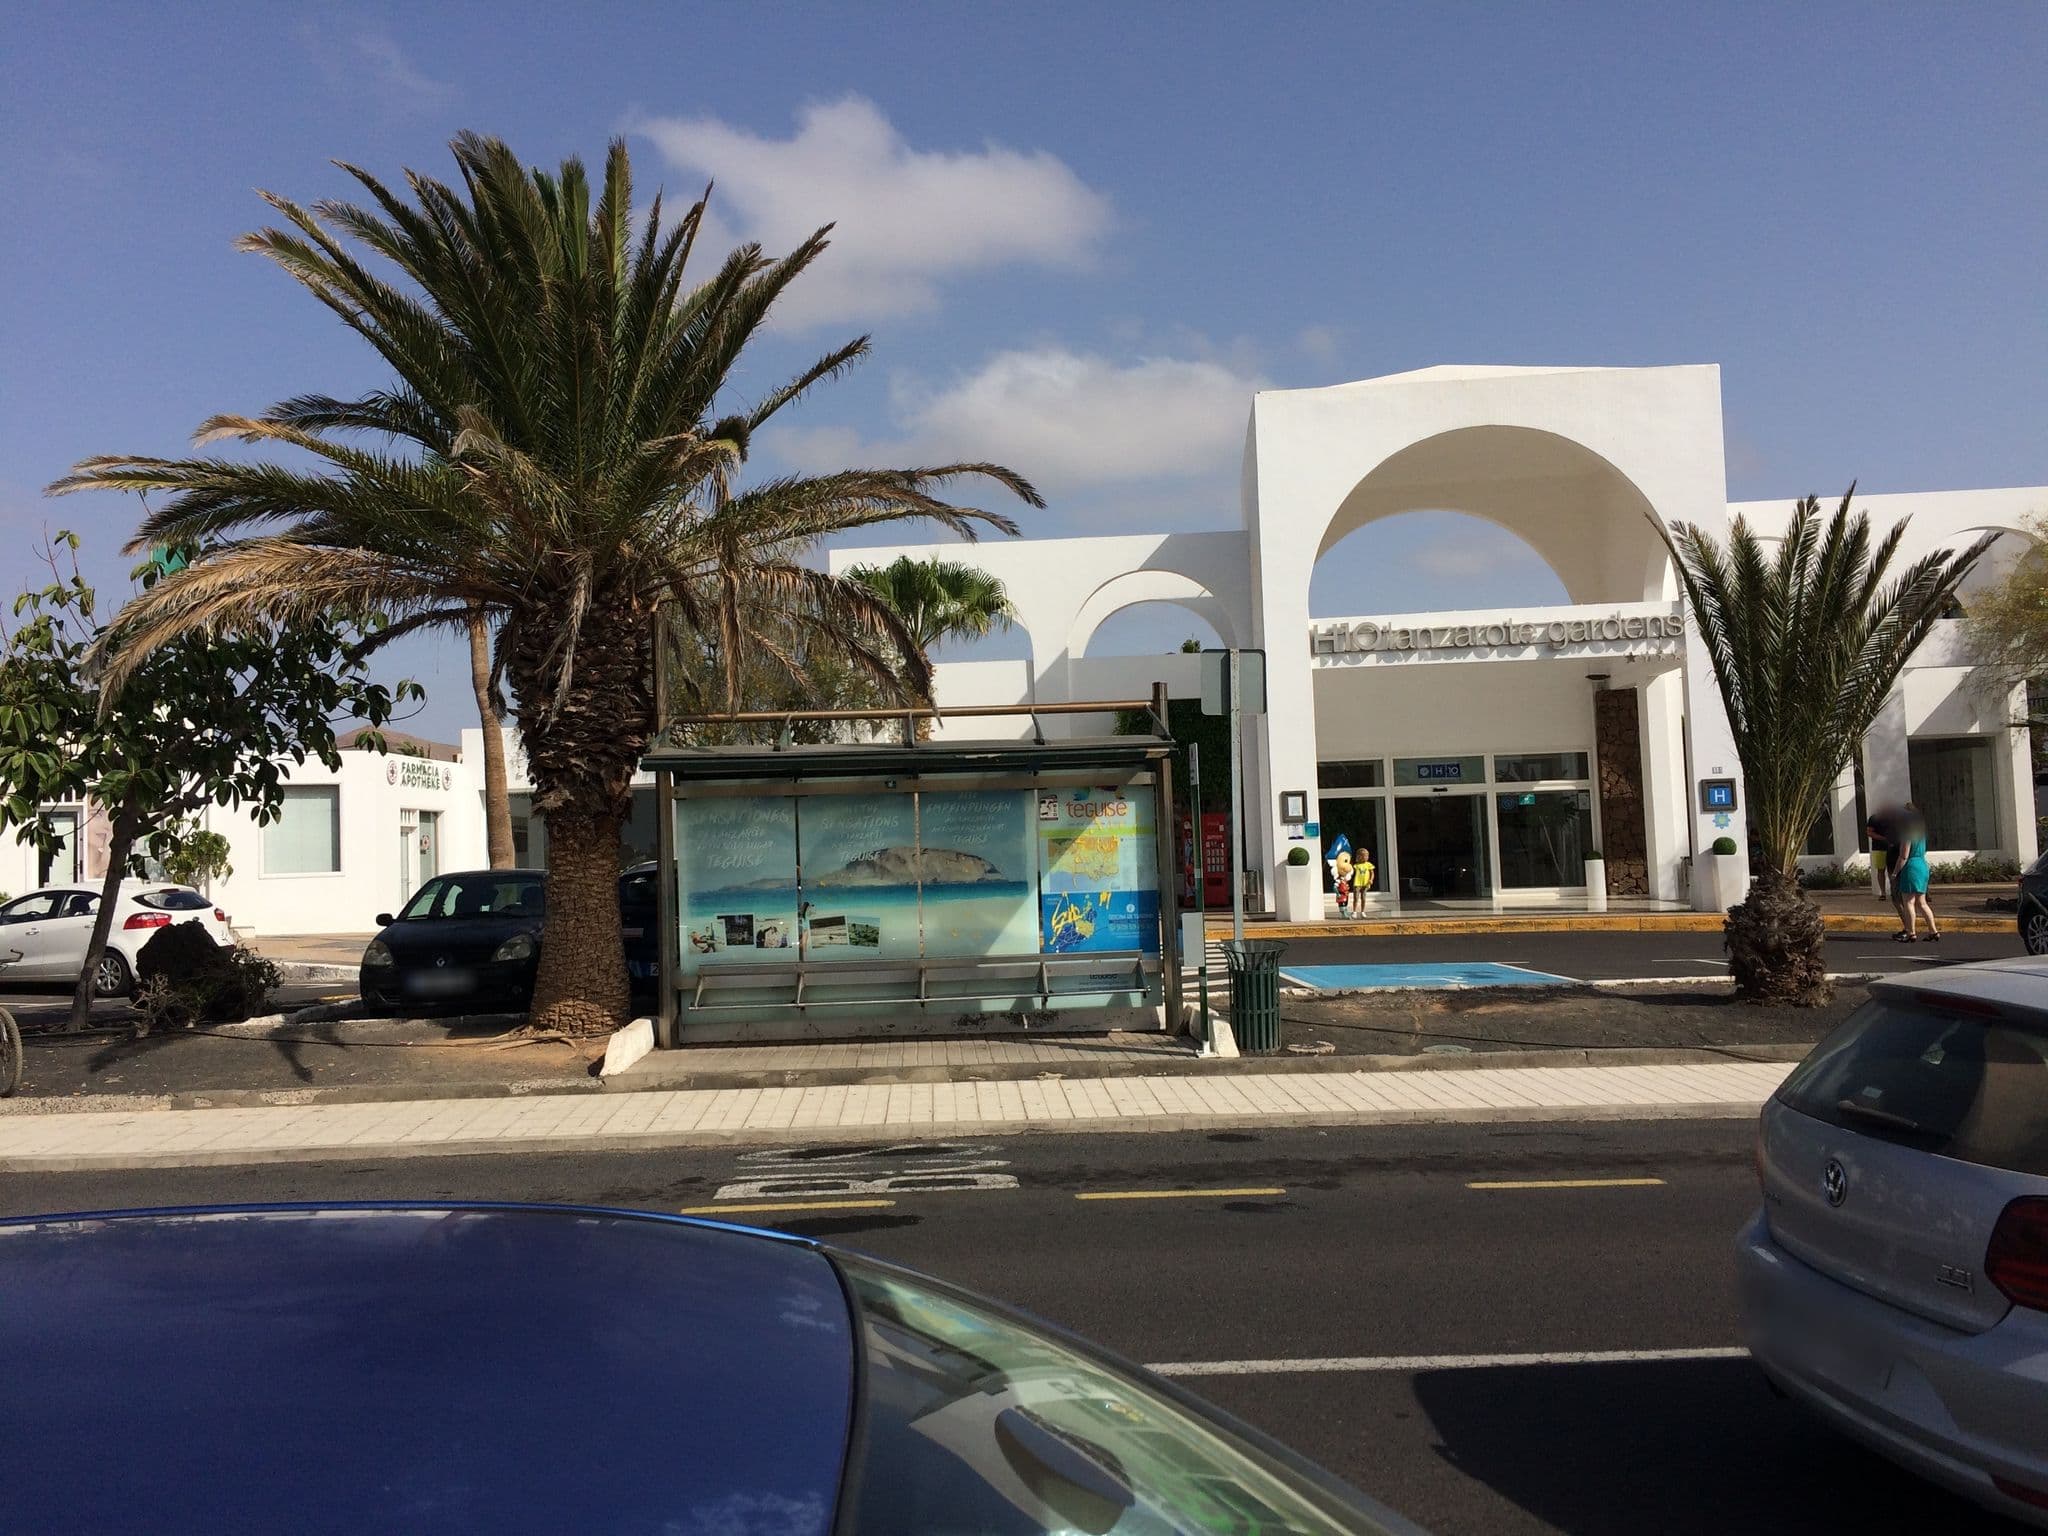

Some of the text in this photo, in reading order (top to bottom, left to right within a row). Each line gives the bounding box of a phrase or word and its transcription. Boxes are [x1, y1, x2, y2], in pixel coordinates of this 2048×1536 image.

[1386, 618, 1537, 652] lanzarote
[1548, 610, 1685, 650] gardens
[401, 762, 440, 777] FARMACIA
[401, 775, 440, 790] APOTHEKE
[1714, 789, 1726, 803] H
